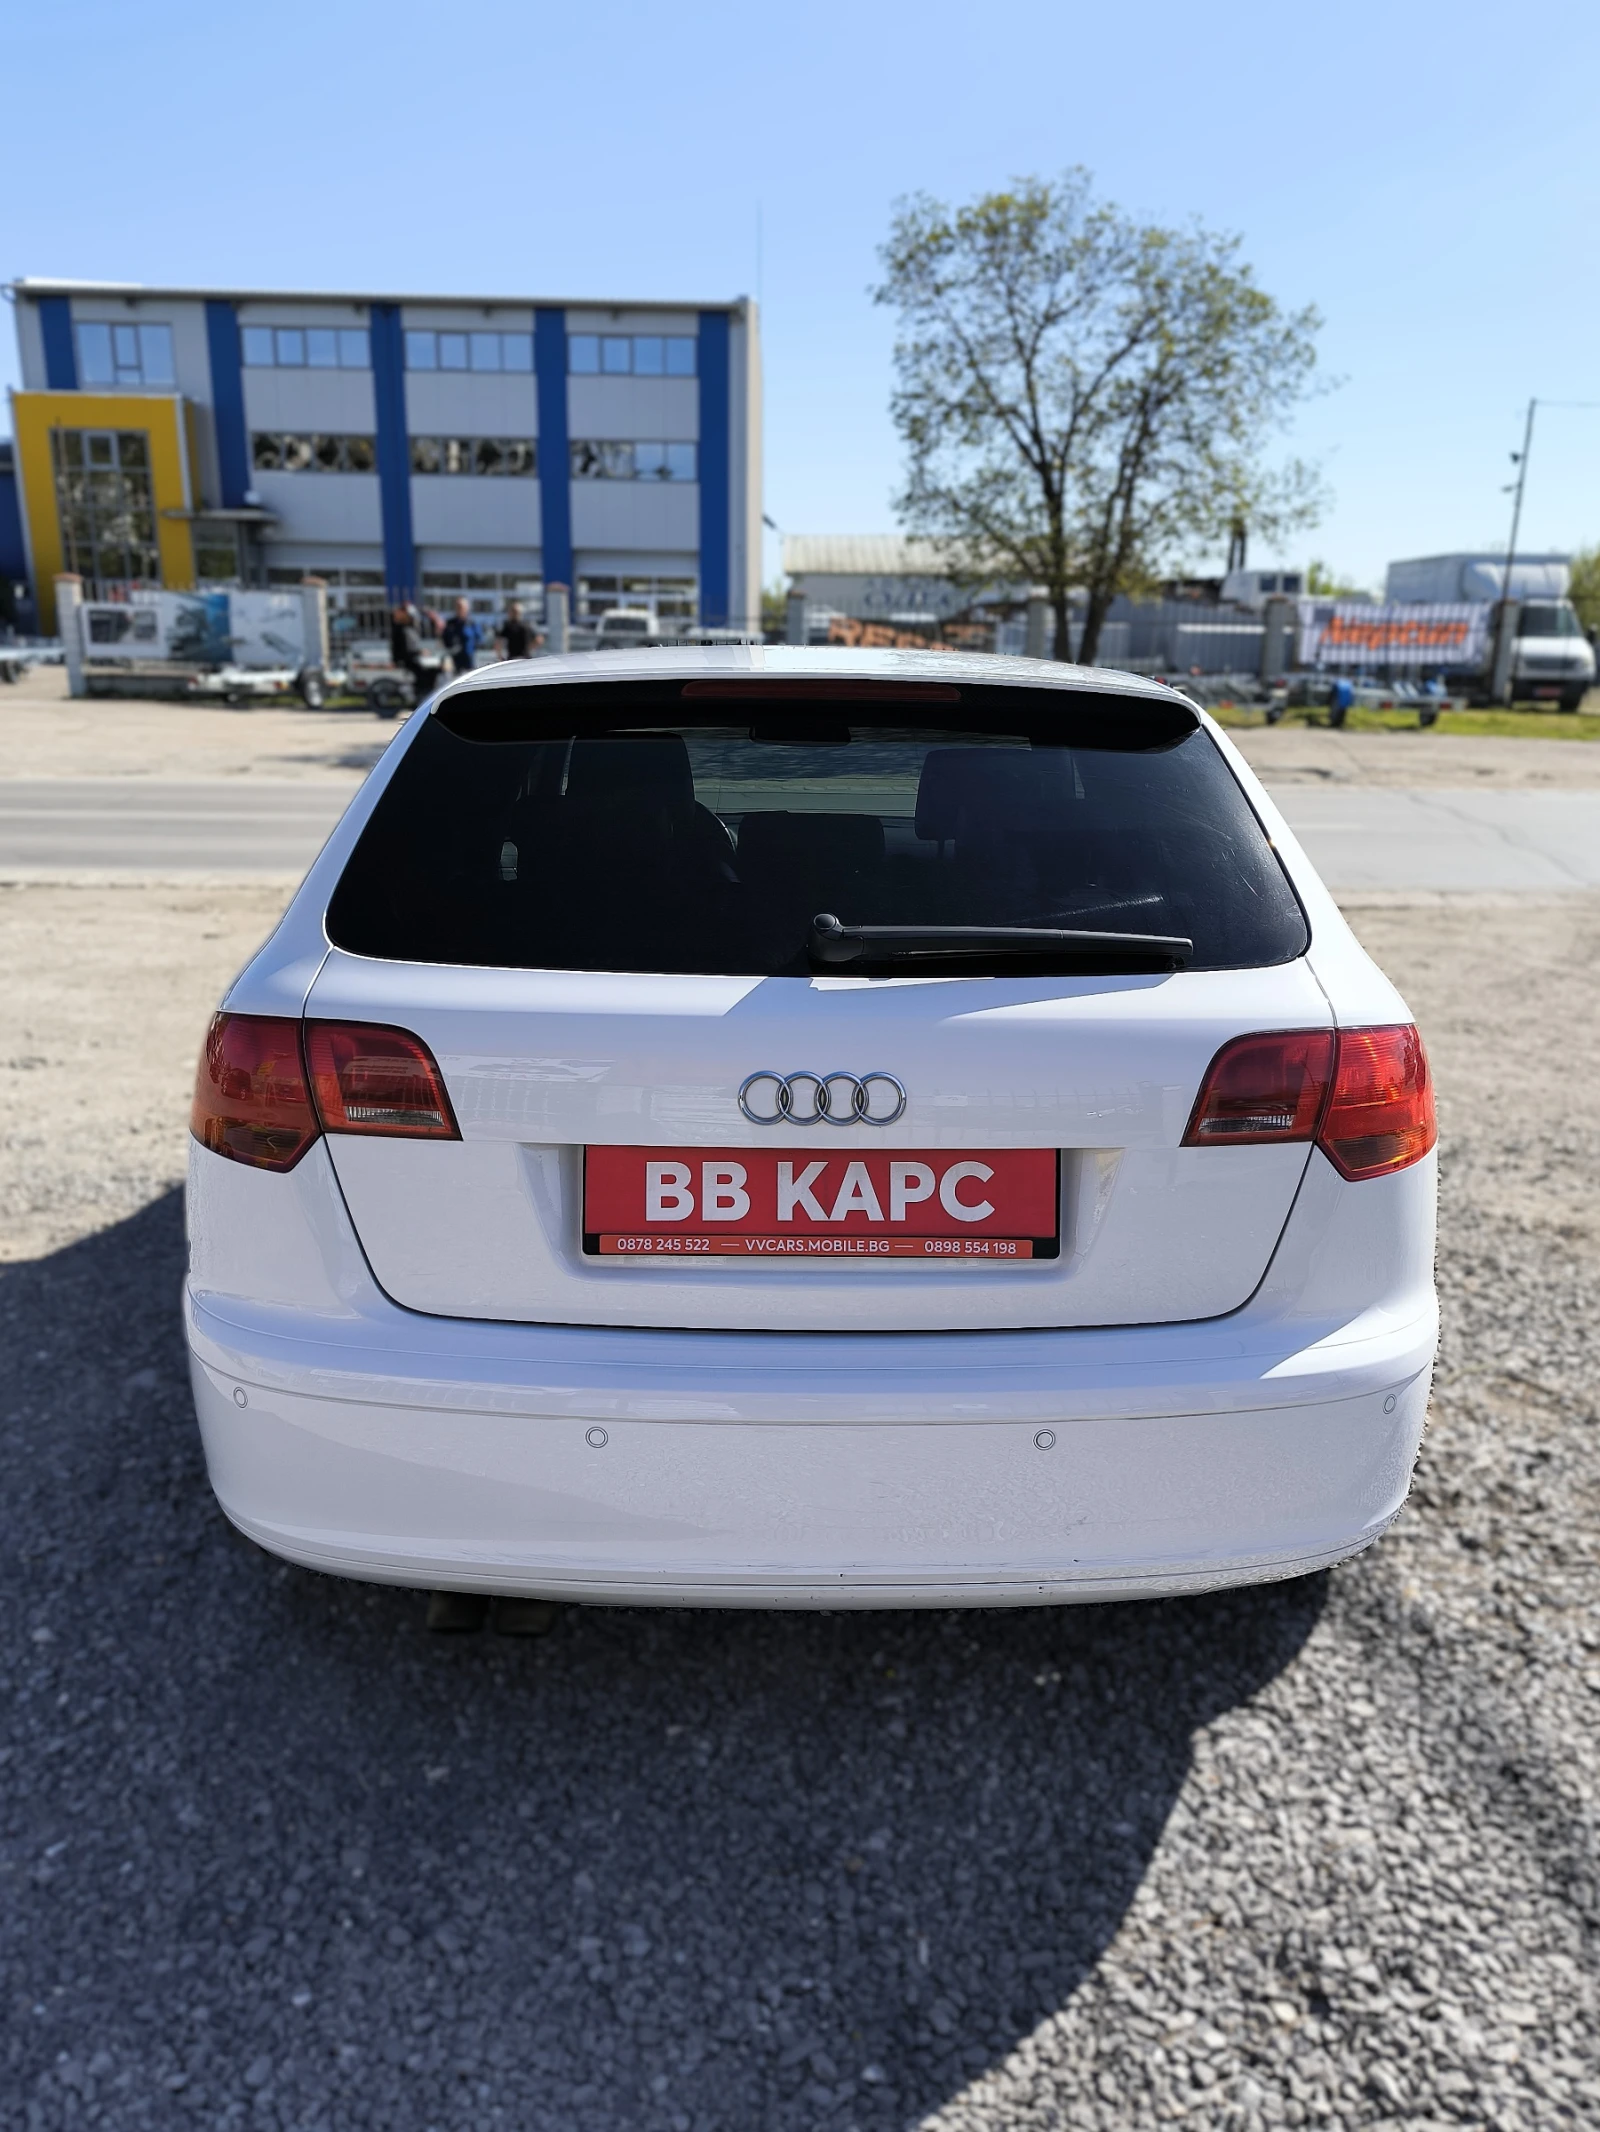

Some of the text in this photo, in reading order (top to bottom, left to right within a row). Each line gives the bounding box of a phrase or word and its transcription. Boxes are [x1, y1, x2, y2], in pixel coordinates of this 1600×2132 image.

[777, 1160, 996, 1222] КАРС
[617, 1238, 1017, 1254] 0878 245 522 VVCARS.MOBILE.BG 0898 554 198
